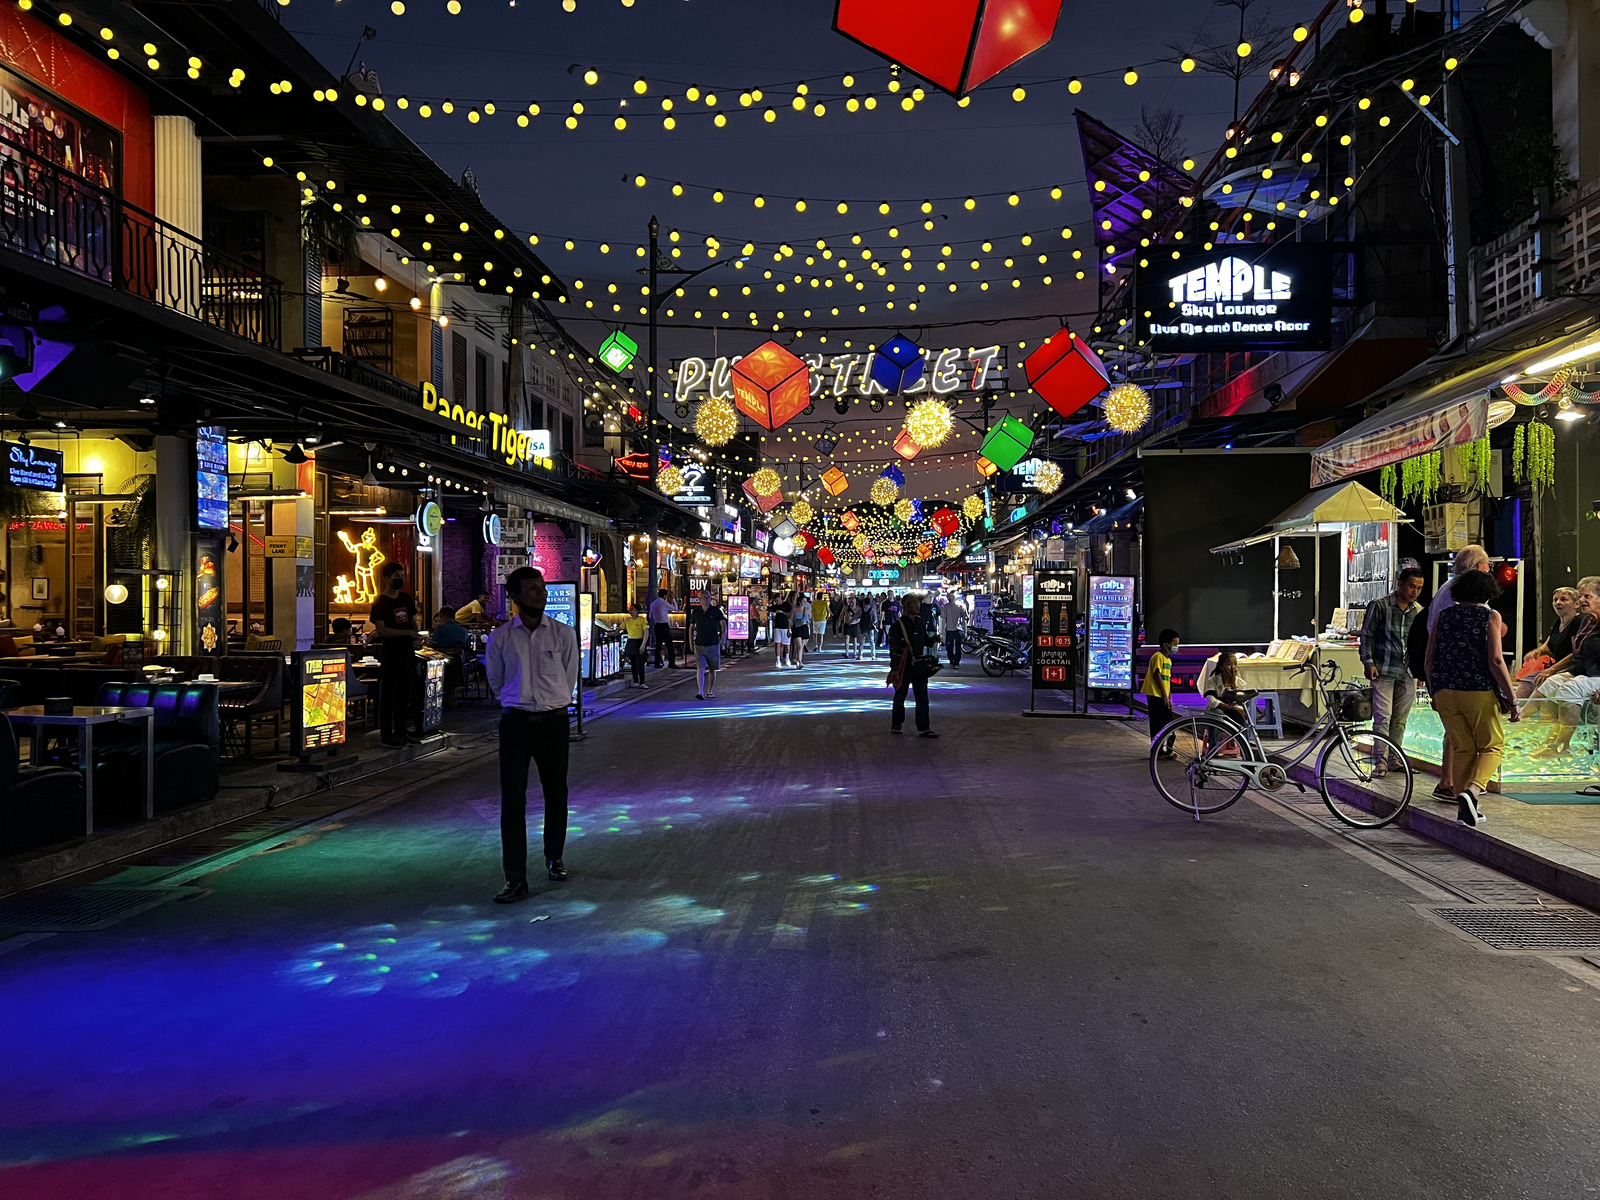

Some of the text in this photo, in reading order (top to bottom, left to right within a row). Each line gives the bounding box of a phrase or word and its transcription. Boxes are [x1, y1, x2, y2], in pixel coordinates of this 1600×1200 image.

[1168, 256, 1292, 302] TEMPLE
[1181, 302, 1277, 318] Sky Lounge
[1150, 323, 1179, 334] Live
[1204, 322, 1231, 333] and
[1232, 321, 1273, 332] Dance
[736, 387, 767, 415] TEMPLE
[489, 411, 533, 466] Tiger
[529, 441, 545, 451] ISA
[9, 446, 29, 468] Sky
[690, 579, 708, 590] BUY
[1040, 579, 1066, 589] TEMPLE
[1099, 580, 1125, 589] TEMPLE
[547, 590, 571, 598] EARS
[1045, 667, 1063, 680] 1+1
